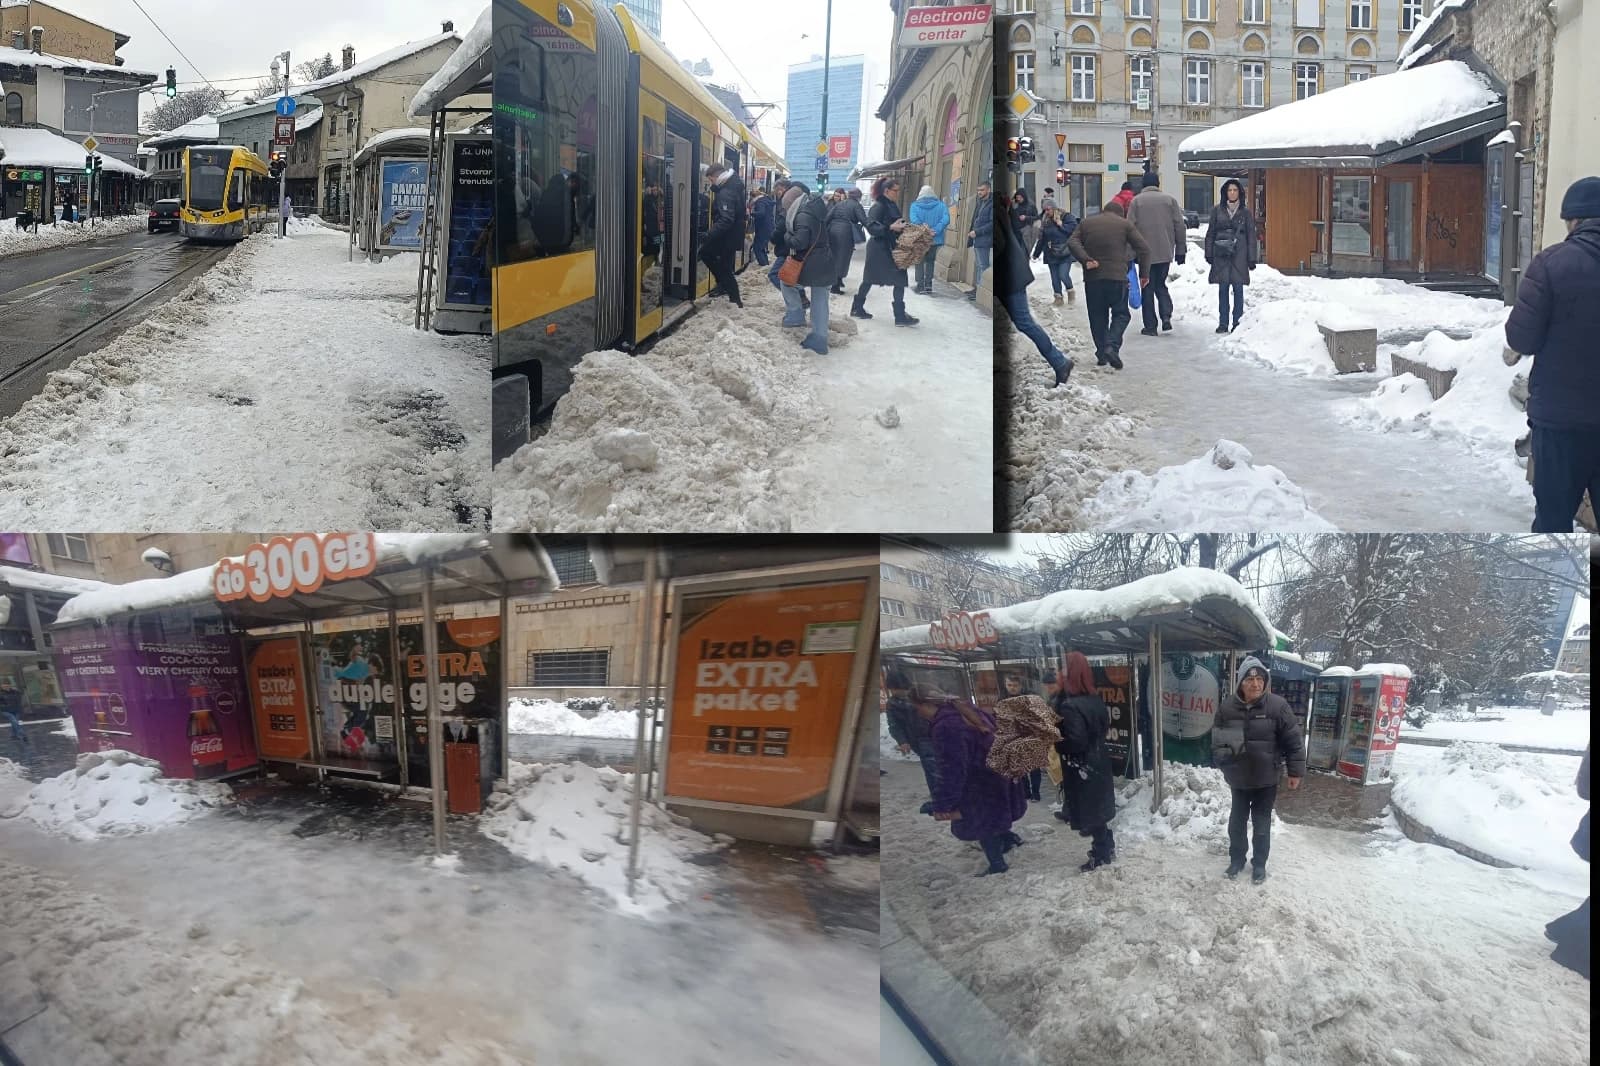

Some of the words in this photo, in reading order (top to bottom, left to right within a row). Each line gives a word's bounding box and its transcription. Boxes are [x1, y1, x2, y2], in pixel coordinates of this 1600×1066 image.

[910, 8, 986, 25] electronic
[918, 28, 967, 41] centar
[216, 565, 245, 596] do
[248, 537, 319, 596] 300
[324, 534, 371, 574] GB
[942, 615, 975, 648] 300
[974, 616, 995, 639] GB
[160, 655, 220, 665] COCA-COLA
[698, 635, 805, 661] Izabe
[259, 679, 297, 694] EXTRA
[695, 660, 818, 688] EXTRA
[329, 678, 396, 711] duple
[409, 682, 476, 712] gge
[692, 689, 800, 717] paket
[1161, 691, 1214, 714] SELJAK
